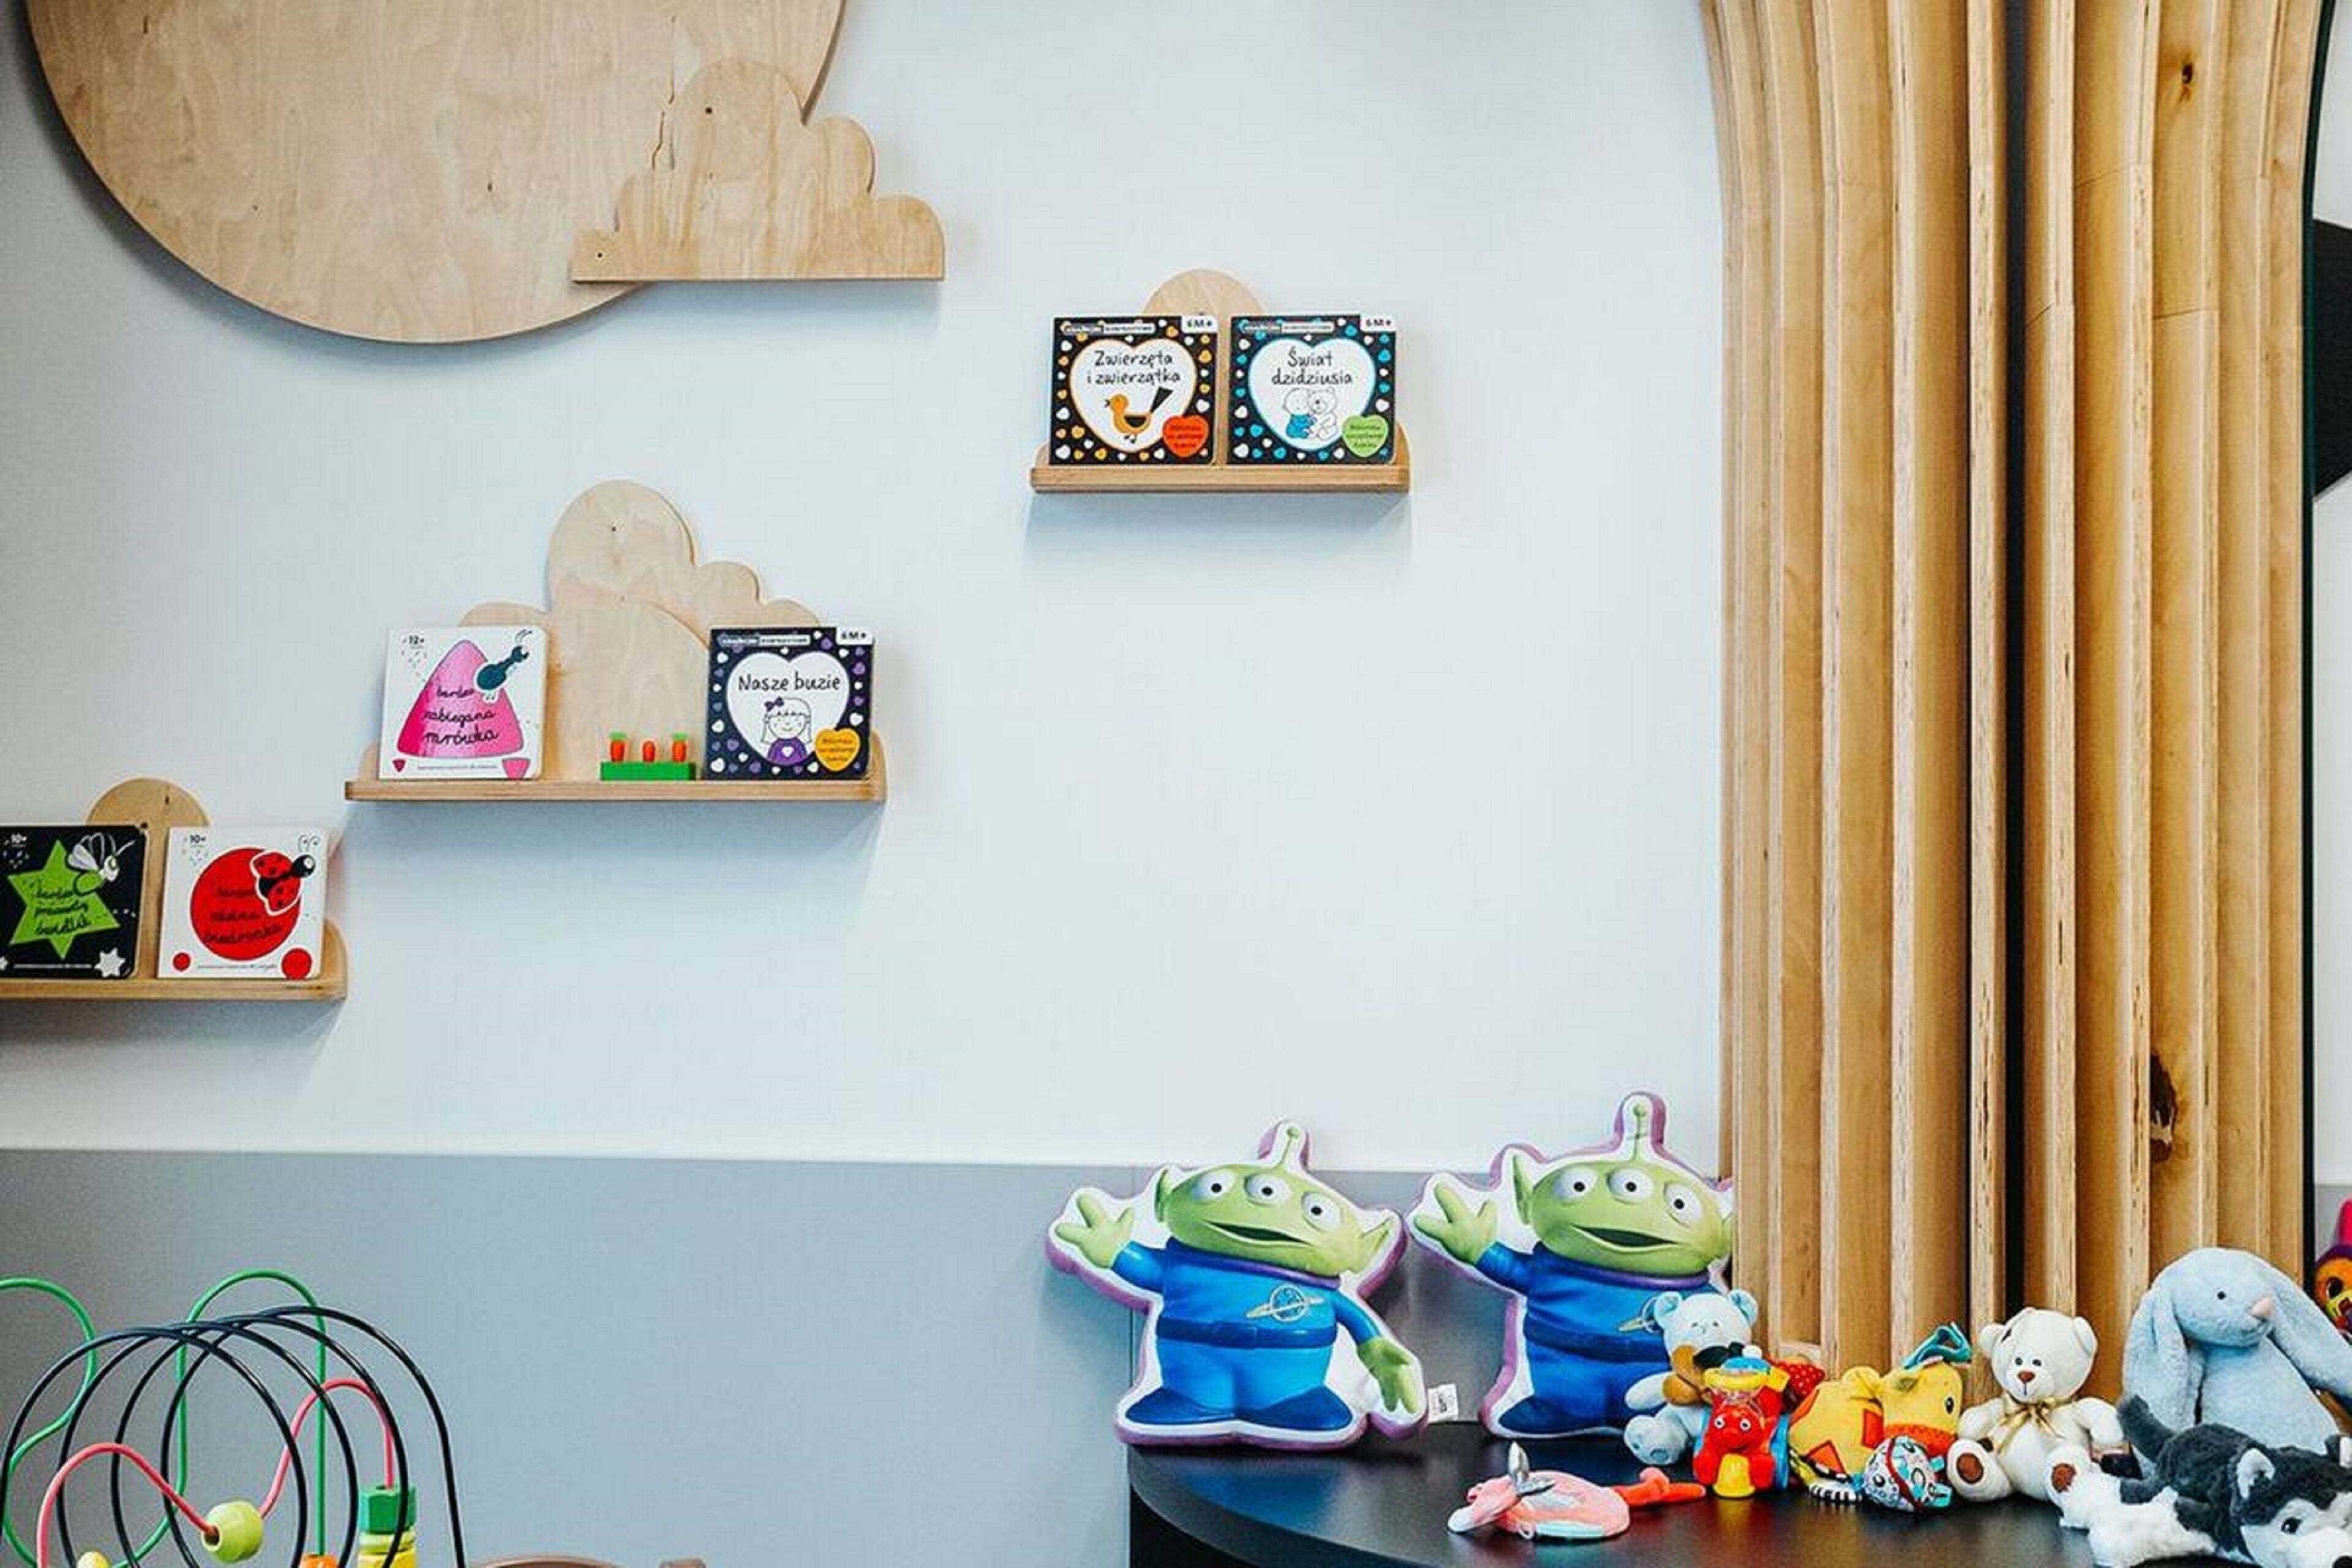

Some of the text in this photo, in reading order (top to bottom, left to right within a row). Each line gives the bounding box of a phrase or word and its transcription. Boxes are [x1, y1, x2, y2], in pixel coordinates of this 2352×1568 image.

[1094, 350, 1173, 368] Zwierzęta
[1287, 346, 1333, 368] Świat
[1087, 368, 1181, 386] i zwierzątka
[1271, 368, 1353, 386] dzidziusia
[738, 670, 841, 691] Nasze buzie
[423, 724, 499, 745] mrówka
